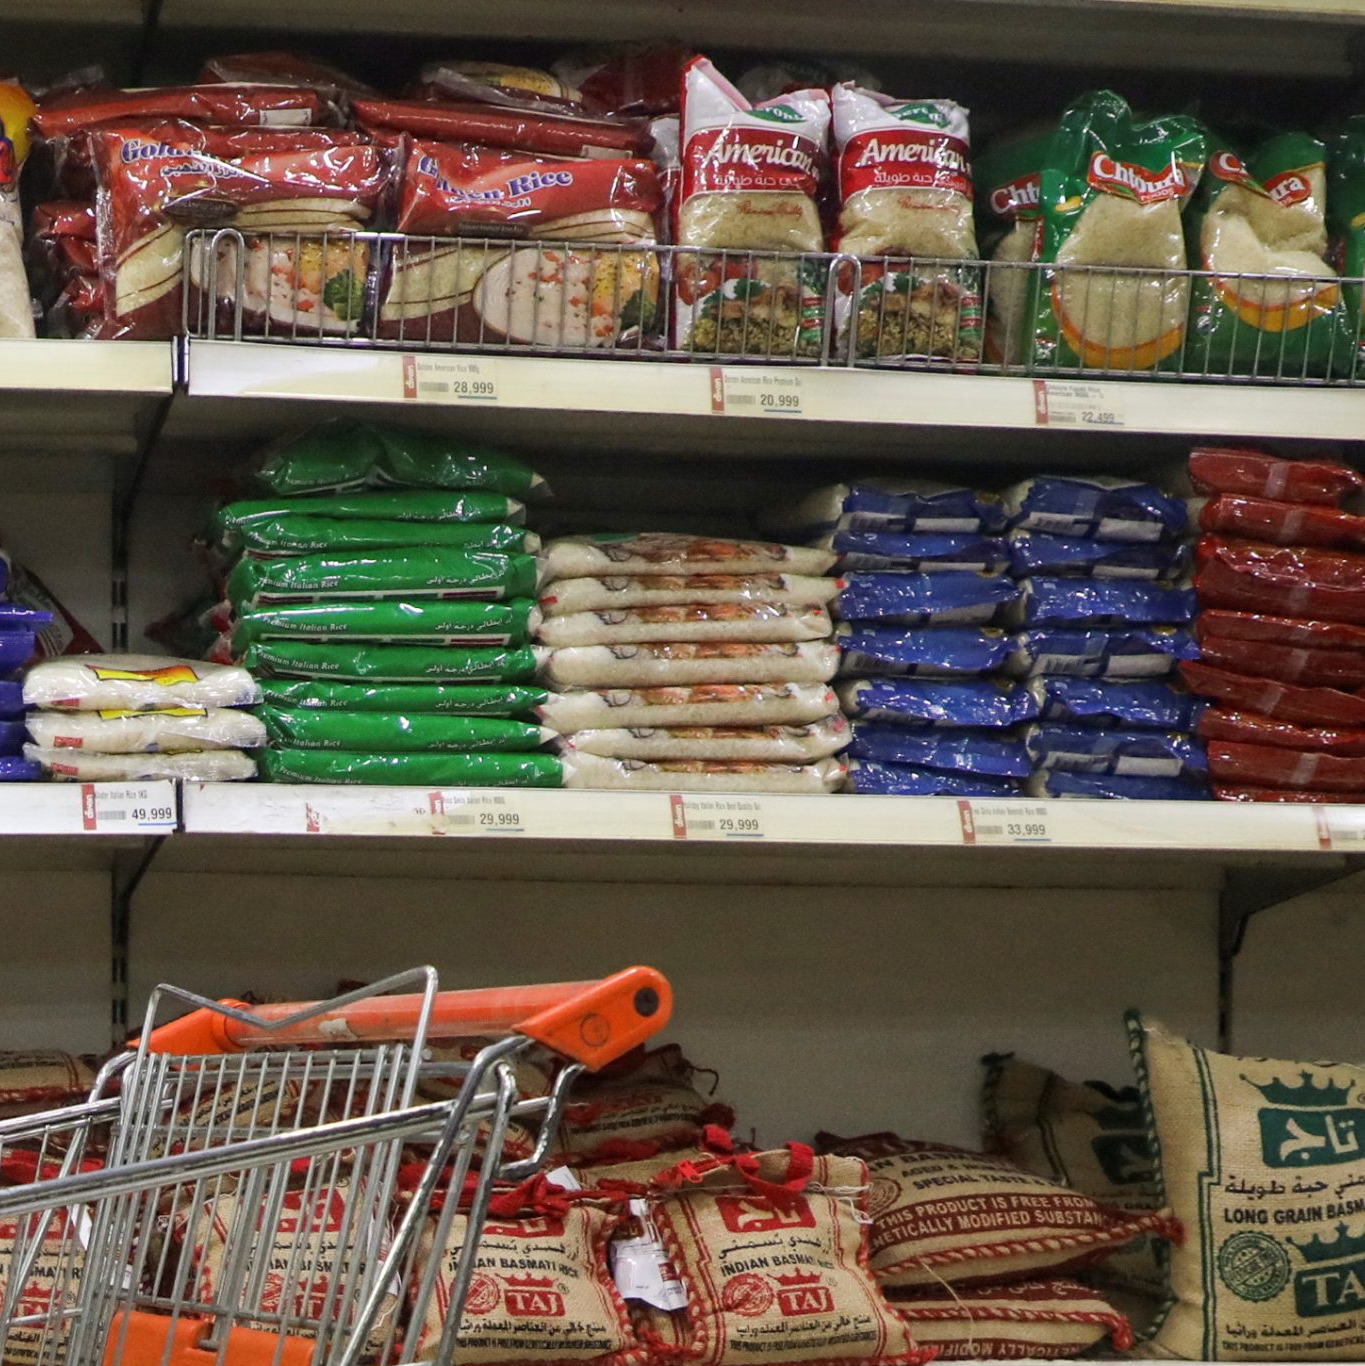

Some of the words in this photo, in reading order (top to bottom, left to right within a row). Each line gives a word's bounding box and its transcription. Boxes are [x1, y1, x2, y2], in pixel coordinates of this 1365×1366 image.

[701, 137, 813, 176] American
[855, 137, 966, 174] American
[1093, 153, 1185, 194] Chtoura
[508, 170, 574, 198] Rice
[453, 381, 494, 395] 28,999
[760, 394, 799, 407] 20,999
[291, 581, 319, 590] Italian
[321, 579, 339, 590] Rice
[299, 623, 328, 632] Italian
[330, 623, 348, 632] Rice
[292, 660, 319, 670] Italian
[321, 662, 340, 671] Rice
[330, 699, 349, 708] Rice
[292, 738, 321, 748] Italian
[323, 739, 342, 748] Rice
[131, 807, 173, 821] 49,999
[479, 813, 520, 826] 29,999
[719, 818, 760, 831] 29,999
[1007, 823, 1046, 835] 33,999
[1278, 1113, 1361, 1163] تاج
[912, 1174, 976, 1190] SPECIAL
[1224, 1174, 1286, 1201] طويلة
[1291, 1174, 1330, 1199] حبة
[879, 1210, 914, 1230] THIS
[915, 1197, 988, 1218] PRODUCT
[991, 1197, 1008, 1210] IS
[1011, 1196, 1052, 1209] FREE
[1054, 1197, 1098, 1209] FROM
[958, 1212, 1032, 1230] MODIFIED
[1223, 1207, 1269, 1225] LONG
[1273, 1205, 1324, 1225] GRAIN
[500, 1258, 557, 1272] BASMATI
[720, 1256, 771, 1277] INDIAN
[506, 1291, 559, 1315] TAJ
[781, 1288, 831, 1312] TAJ
